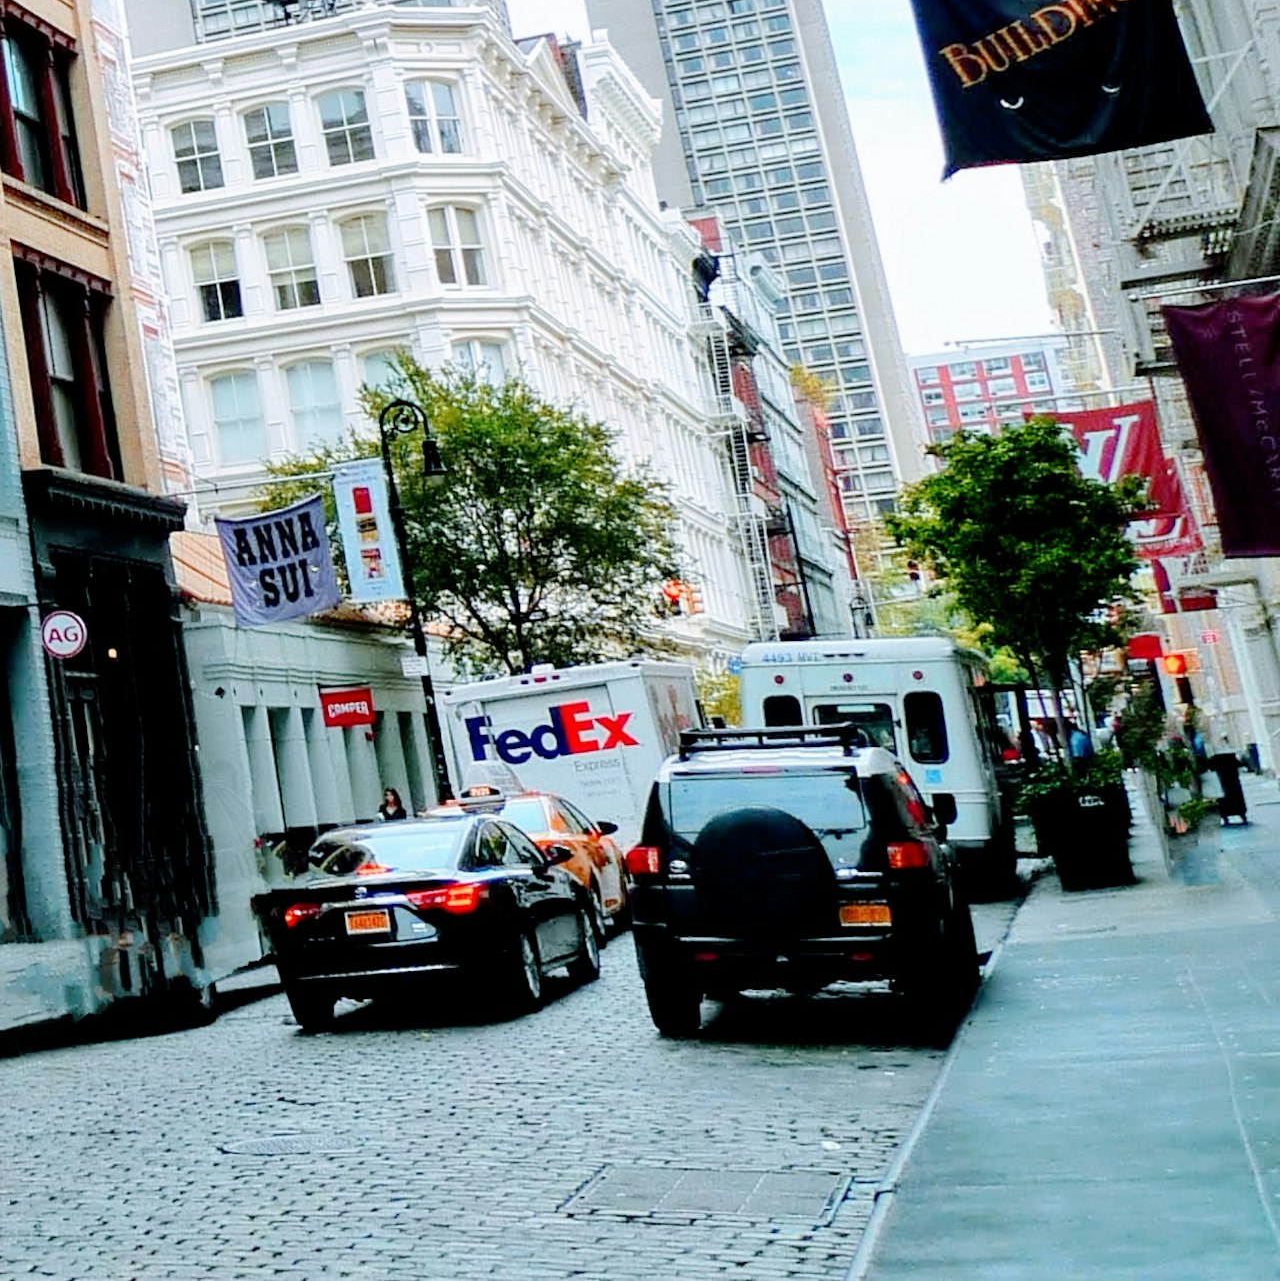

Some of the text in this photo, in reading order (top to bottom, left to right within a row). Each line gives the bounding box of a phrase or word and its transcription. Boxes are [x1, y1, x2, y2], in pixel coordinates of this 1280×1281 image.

[233, 511, 320, 567] ANNA
[258, 558, 314, 608] SUI
[48, 626, 79, 644] AG
[327, 701, 370, 719] CAMPER
[464, 700, 640, 765] FedEx
[573, 757, 621, 773] Express
